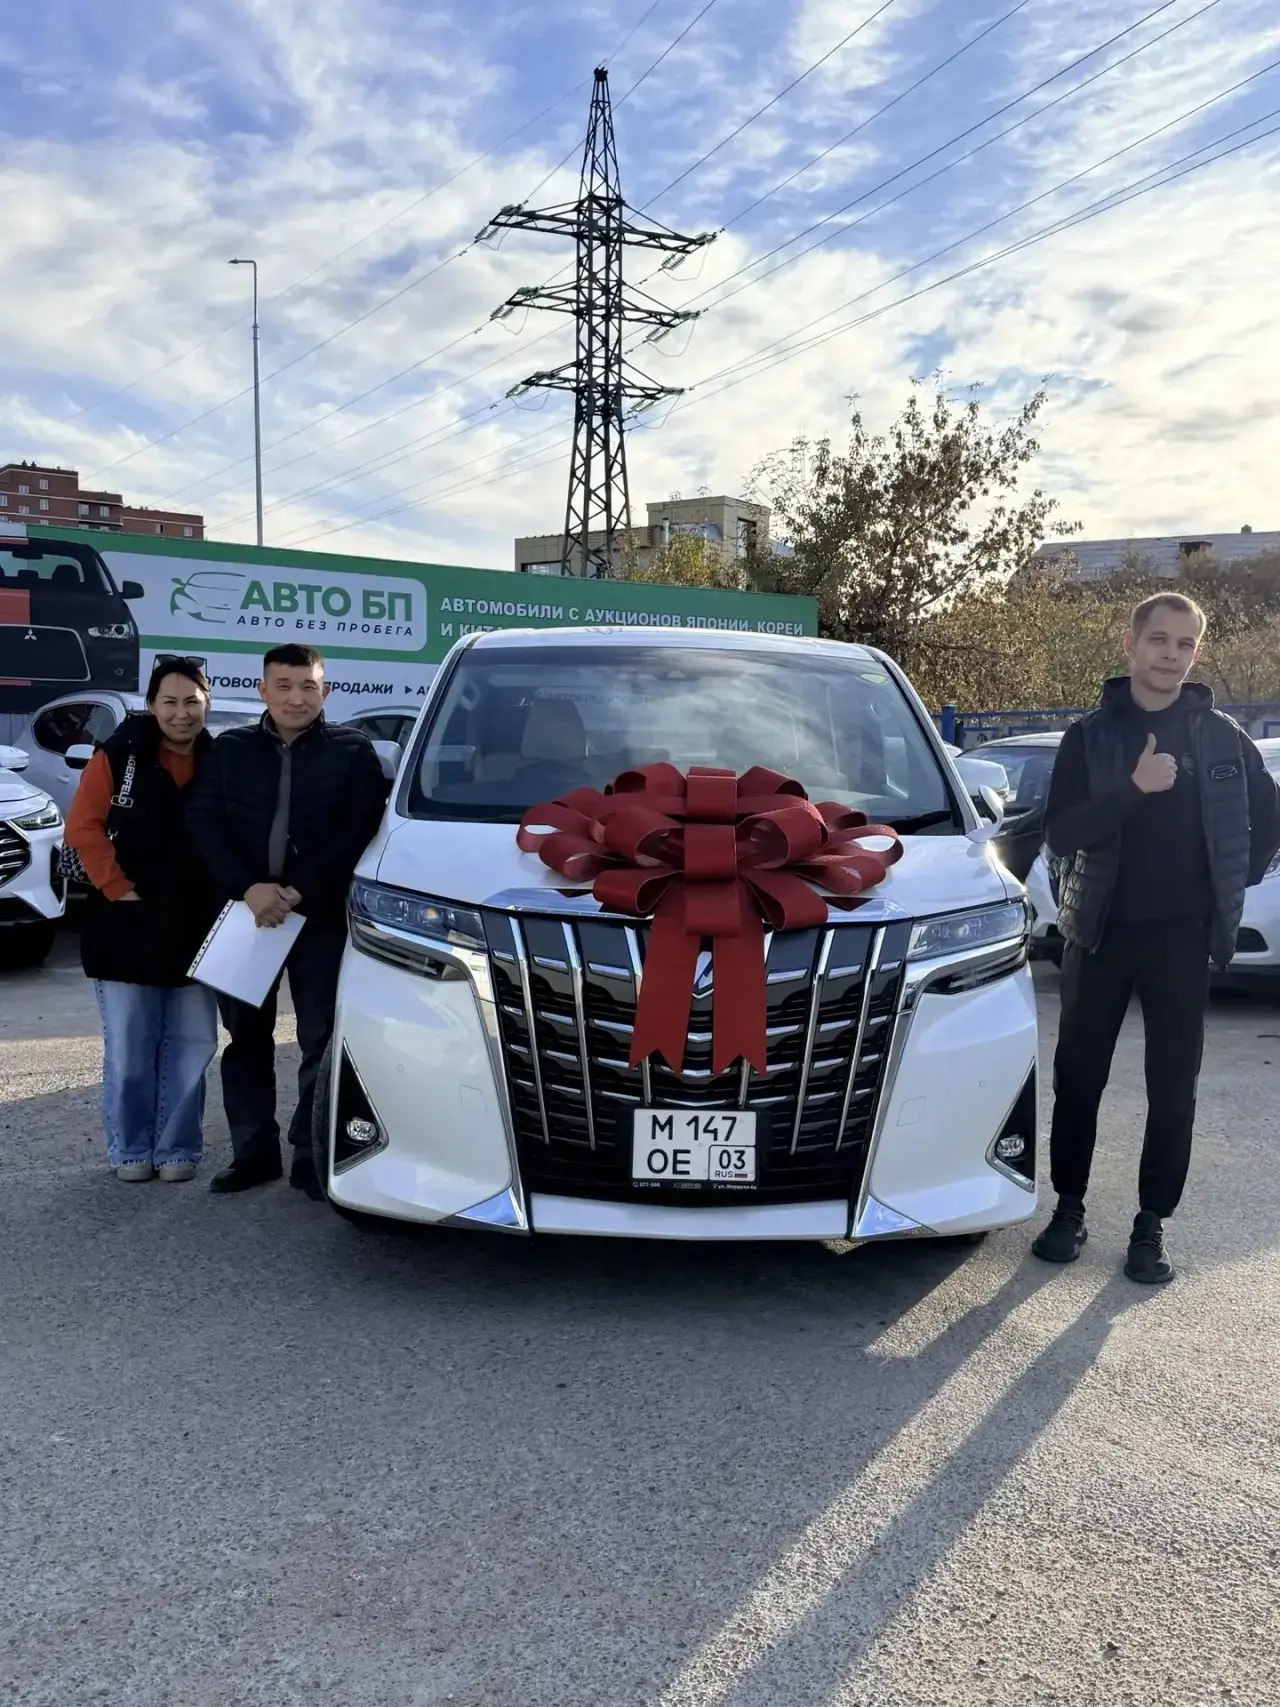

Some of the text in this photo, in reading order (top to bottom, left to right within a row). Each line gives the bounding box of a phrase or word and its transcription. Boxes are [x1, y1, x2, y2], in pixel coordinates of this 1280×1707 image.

[240, 580, 412, 622] АВТО БП
[236, 616, 412, 636] АВТО БЕЗ ПРОБЕГА
[440, 597, 563, 620] АВТОМОБИЛИ
[568, 607, 579, 620] С
[584, 608, 681, 627] АУКЦИОНОВ
[757, 621, 802, 636] КОРЕИ
[440, 622, 453, 637] И
[651, 1114, 737, 1142] М 147
[647, 1148, 691, 1175] ОЕ
[718, 1149, 746, 1170] 03
[714, 1170, 734, 1178] RUS
